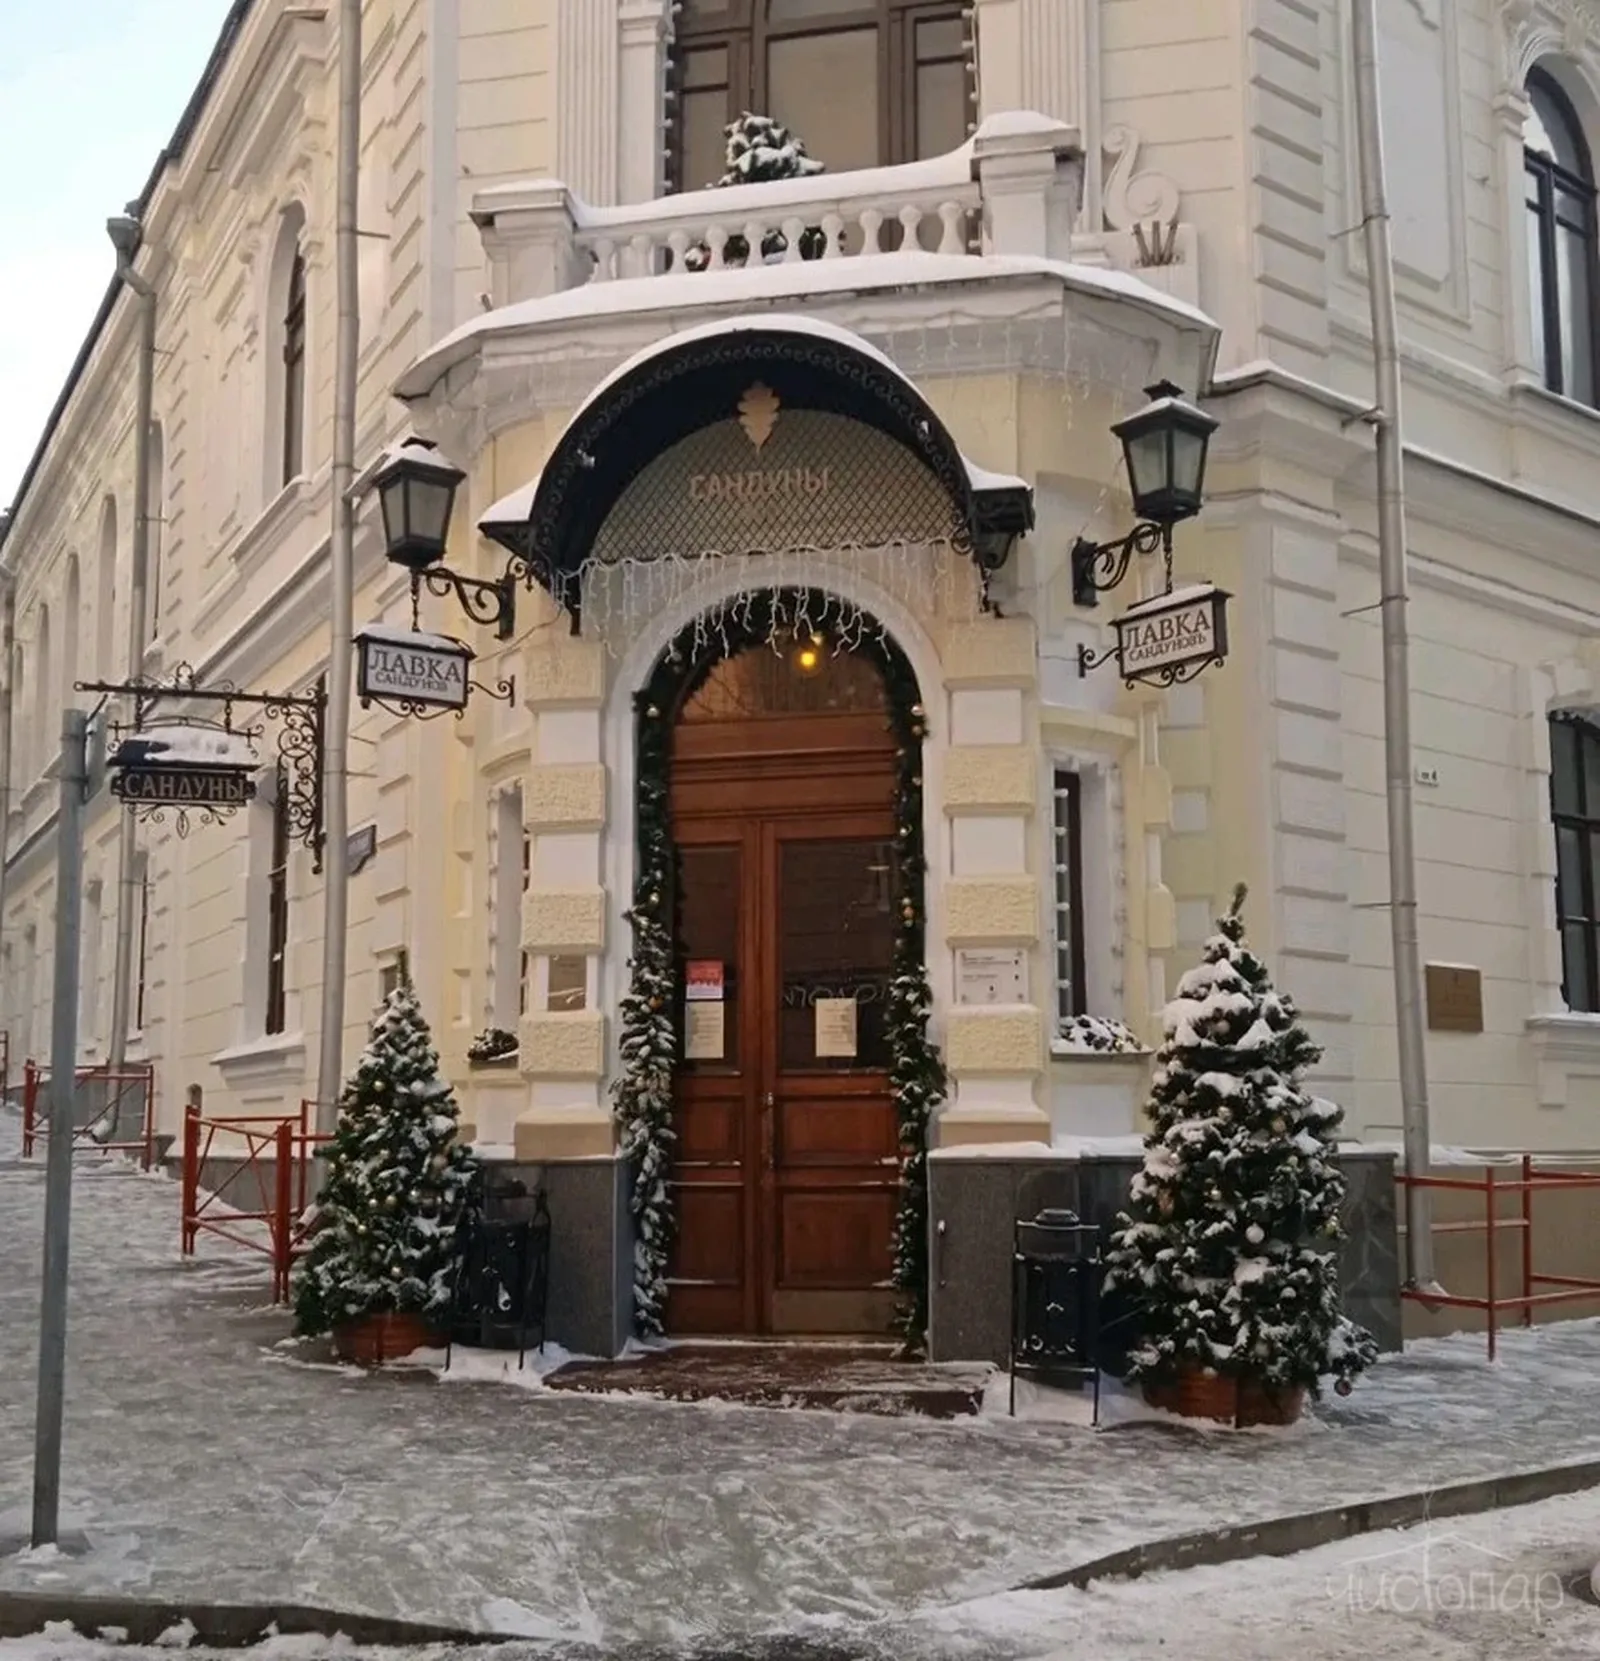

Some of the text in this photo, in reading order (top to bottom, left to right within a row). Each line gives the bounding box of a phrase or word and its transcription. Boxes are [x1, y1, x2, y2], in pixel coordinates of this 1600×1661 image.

[689, 466, 829, 501] САНДУНЫ
[1122, 608, 1211, 652] ЛАВКА
[368, 649, 462, 683] ЛАВКА
[124, 772, 246, 800] САНДУНЫ
